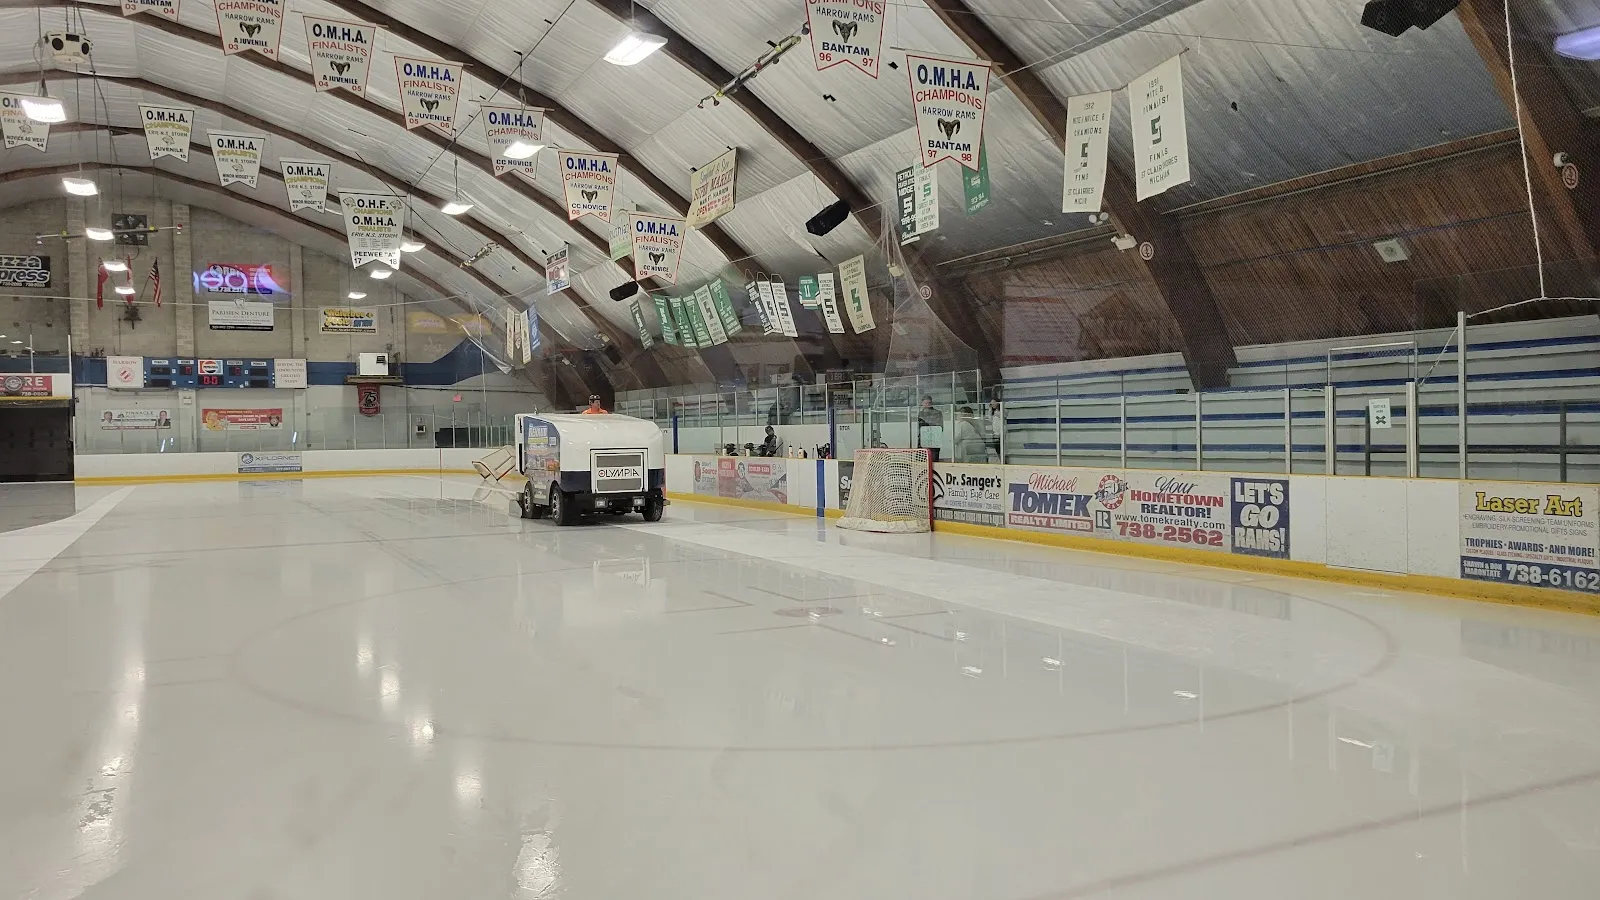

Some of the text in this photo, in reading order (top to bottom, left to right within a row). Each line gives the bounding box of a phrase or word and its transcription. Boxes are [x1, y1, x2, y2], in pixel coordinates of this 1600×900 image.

[218, 2, 281, 19] CHAMPIONS
[816, 6, 850, 19] HARROW
[852, 11, 875, 23] RAMS
[225, 13, 275, 25] HARROW RAMS
[313, 23, 367, 44] O.M.H.A.
[240, 38, 268, 47] JUVENILE
[312, 42, 368, 57] FINALISTS
[822, 42, 870, 56] BANTAM
[316, 51, 364, 64] HARROW RAMS
[819, 53, 874, 67] 96 97
[404, 63, 455, 82] O.M.H.A.
[917, 64, 980, 91] O.M.H.A.
[329, 76, 358, 85] JUVENILE
[404, 80, 455, 95] FINALISTS
[408, 90, 451, 101] HARROW RAMS
[916, 89, 982, 110] CHAMPIONS
[147, 111, 188, 123] O.M.H.A.
[415, 112, 452, 122] JUVENILE
[489, 112, 537, 128] O.M.H.A.
[923, 106, 976, 120] HARROW RAMS
[145, 122, 190, 133] CHAMPIONS
[488, 128, 539, 141] CHAMPIONS
[218, 139, 257, 151] O.M.H.A.
[928, 140, 971, 152] BANTAM
[217, 150, 258, 159] FINALISTS
[928, 150, 972, 162] 97 98
[287, 166, 325, 177] O.M.H.A.
[567, 158, 611, 173] O.M.H.A.
[286, 177, 326, 185] CHAMPIONS
[565, 172, 613, 185] CHAMPIONS
[570, 182, 593, 190] HARROW
[358, 199, 389, 209] O.H.F.
[354, 208, 393, 216] CHAMPIONS
[353, 216, 397, 227] O.M.H.A.
[636, 221, 679, 237] O.M.H.A.
[636, 236, 679, 249] FINALISTS
[364, 391, 377, 402] 75
[598, 469, 640, 478] OLYMPIA
[945, 473, 1002, 490] Dr. Sanger's
[1029, 473, 1078, 492] Michael
[1155, 476, 1198, 496] Your
[948, 488, 999, 500] Family Eye Care
[1008, 483, 1093, 518] TOMEK
[1131, 490, 1224, 508] HOMETOWN
[1235, 482, 1284, 506] LET'S
[1141, 504, 1212, 518] REALTOR!
[1476, 492, 1583, 518] Laser Art
[1010, 515, 1091, 530] REALTY LIMITED
[1115, 513, 1225, 530] www.tomekrealty.com
[1240, 505, 1280, 529] GO
[1512, 516, 1545, 525] SCREENING
[1117, 522, 1224, 547] 738-2562
[1509, 525, 1549, 534] PROMOTIONAL
[1551, 528, 1568, 536] GIFTS
[1569, 529, 1587, 537] SIGNS
[1235, 527, 1285, 552] RAMS!
[1465, 538, 1595, 558] TROPHIES AWARDS AND MORE!
[1463, 560, 1484, 568] SHAWN
[1506, 564, 1600, 590] 738-6162
